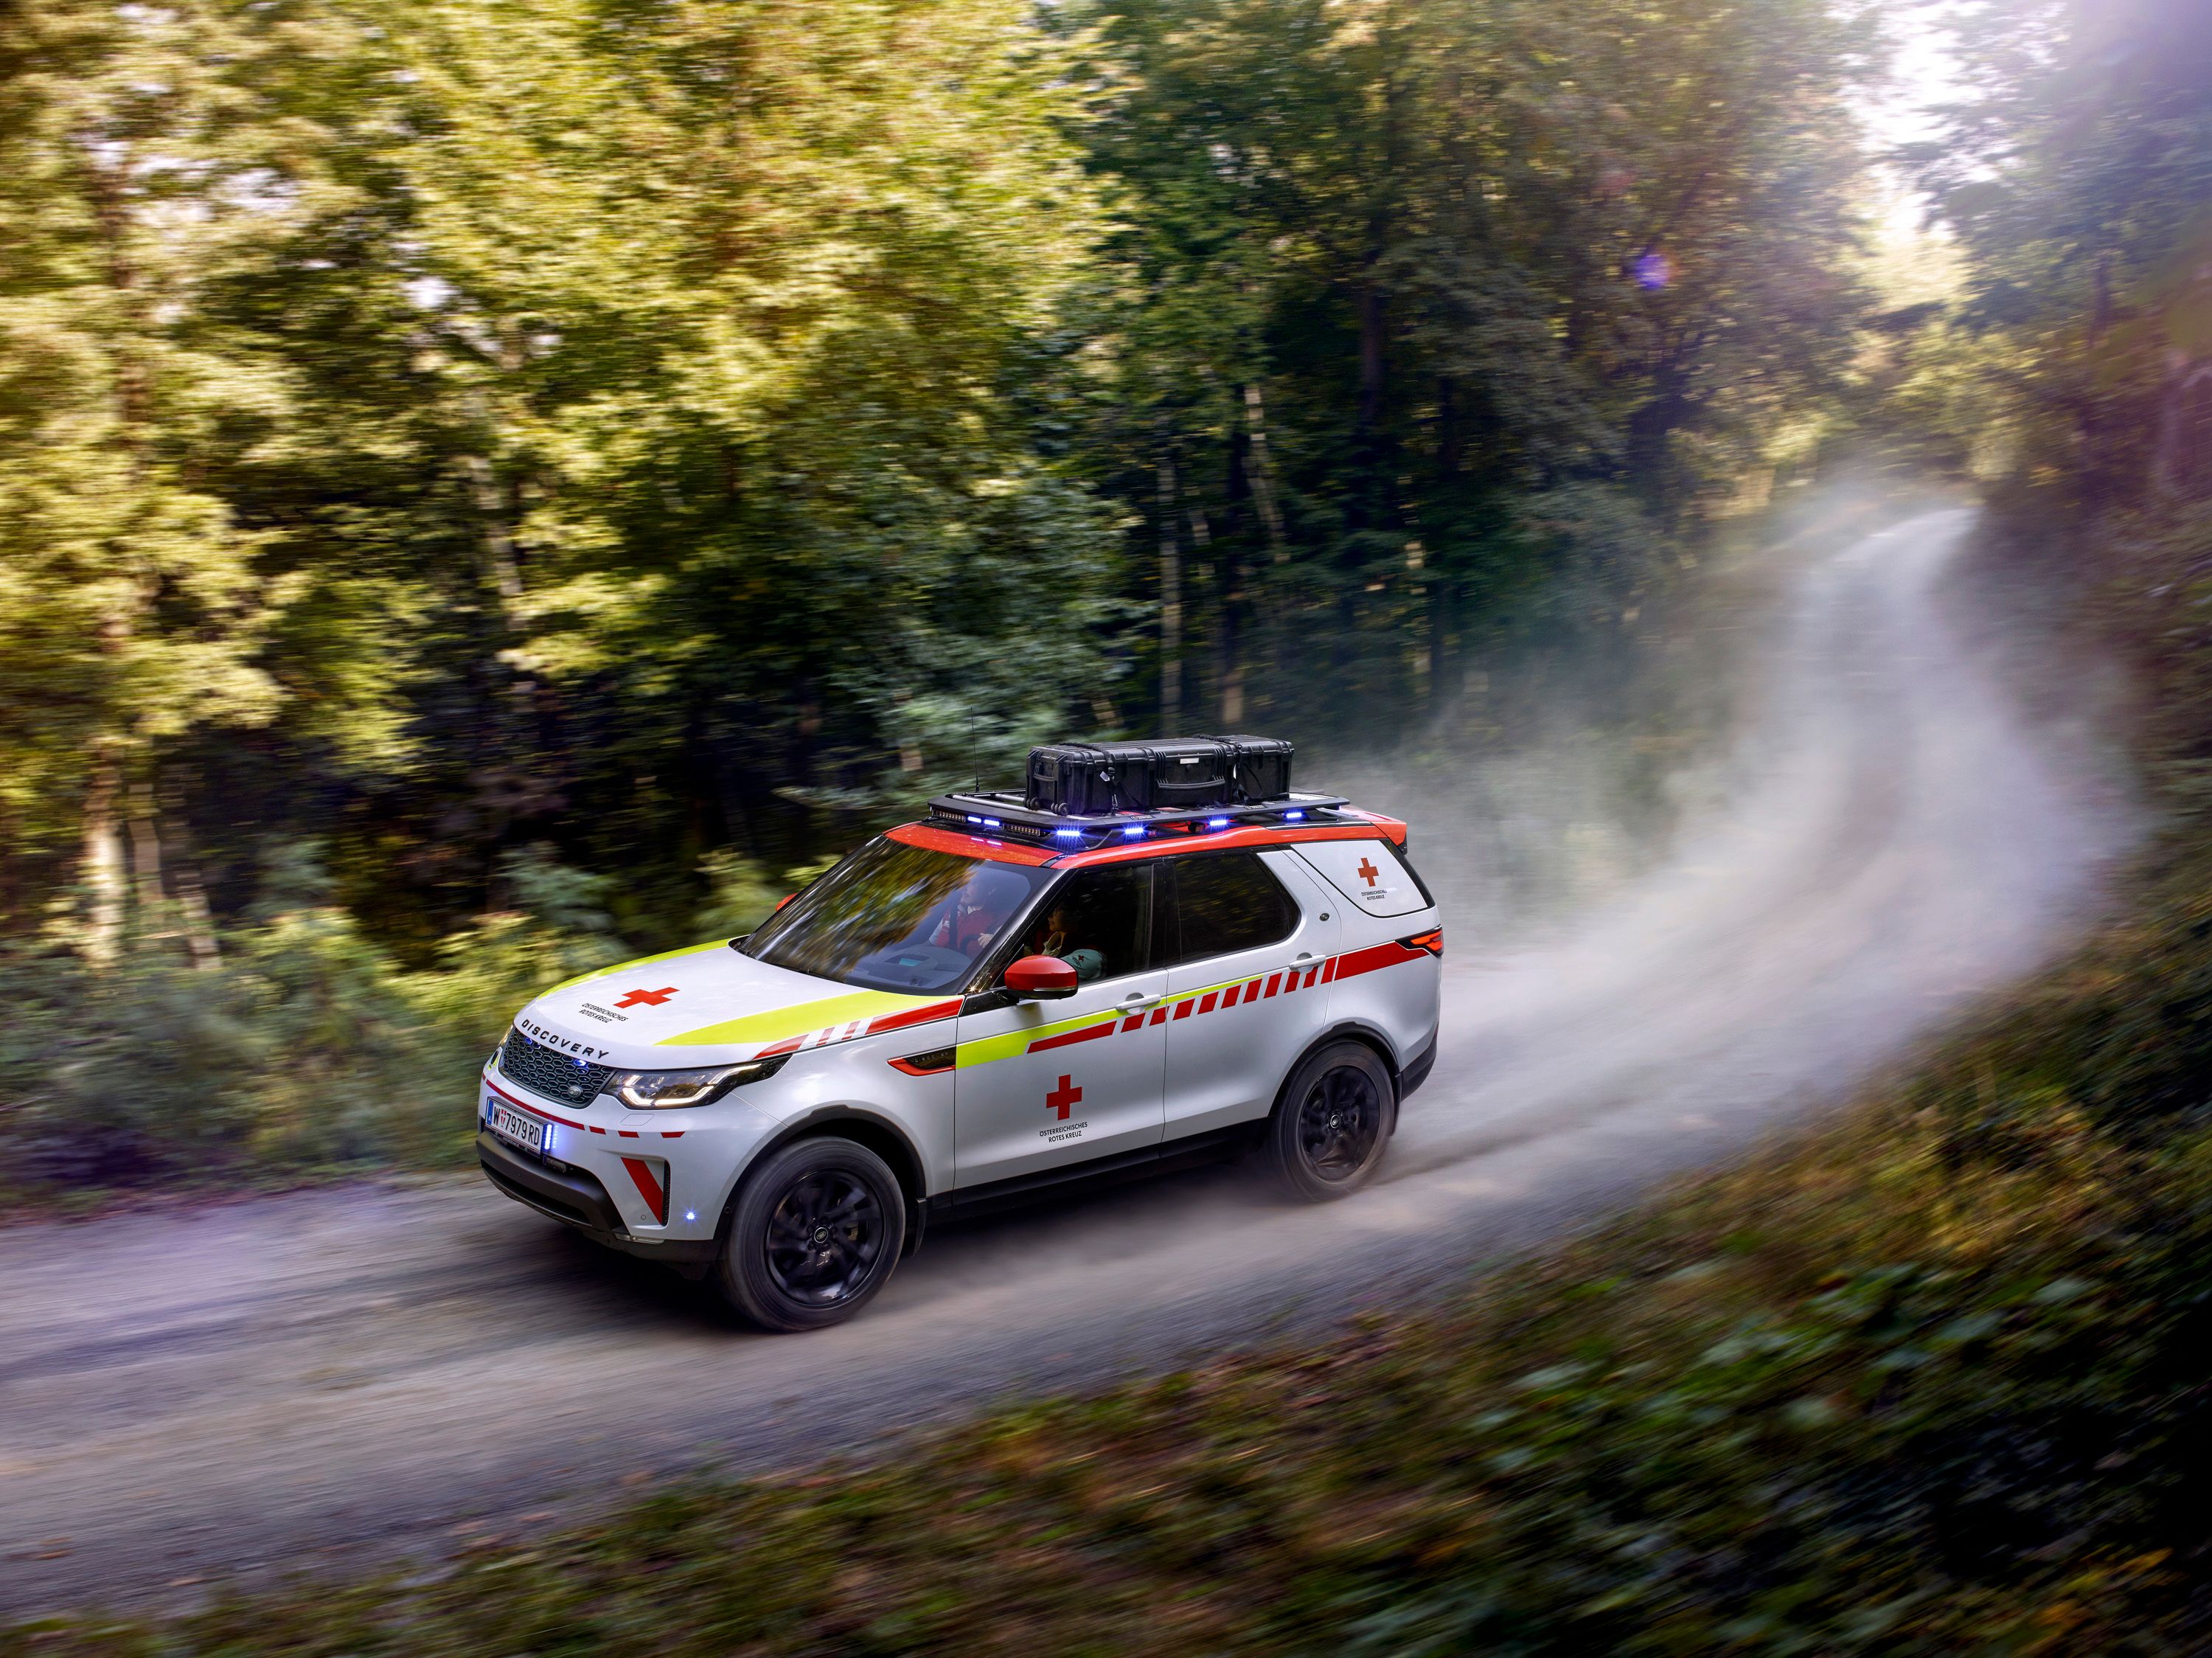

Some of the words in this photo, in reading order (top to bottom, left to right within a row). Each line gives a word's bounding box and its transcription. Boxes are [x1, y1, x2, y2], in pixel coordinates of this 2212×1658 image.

[579, 1009, 597, 1017] ROTES
[593, 1014, 613, 1023] KREUZ
[521, 1019, 610, 1059] DISCOVERY
[493, 1106, 501, 1125] W
[1039, 1121, 1088, 1137] ÖSTERREICHISCHES
[1048, 1134, 1065, 1142] ROTES
[1065, 1130, 1082, 1140] KREUZ
